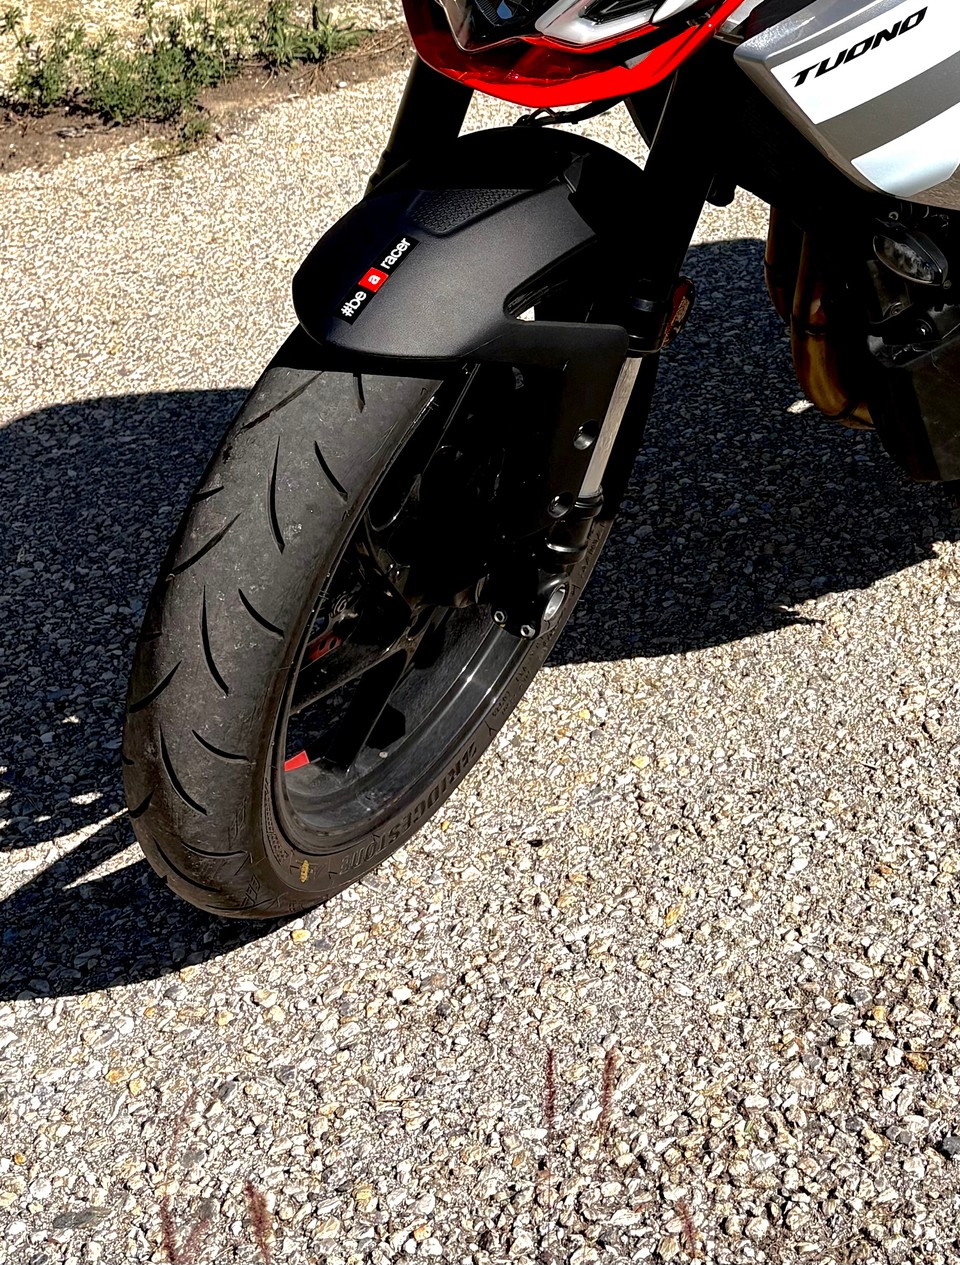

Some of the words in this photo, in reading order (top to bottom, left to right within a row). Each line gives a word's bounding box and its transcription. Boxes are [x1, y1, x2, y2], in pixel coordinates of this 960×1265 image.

[791, 6, 928, 87] TUONO
[341, 291, 367, 317] #be
[368, 274, 381, 285] a
[380, 237, 411, 269] racer
